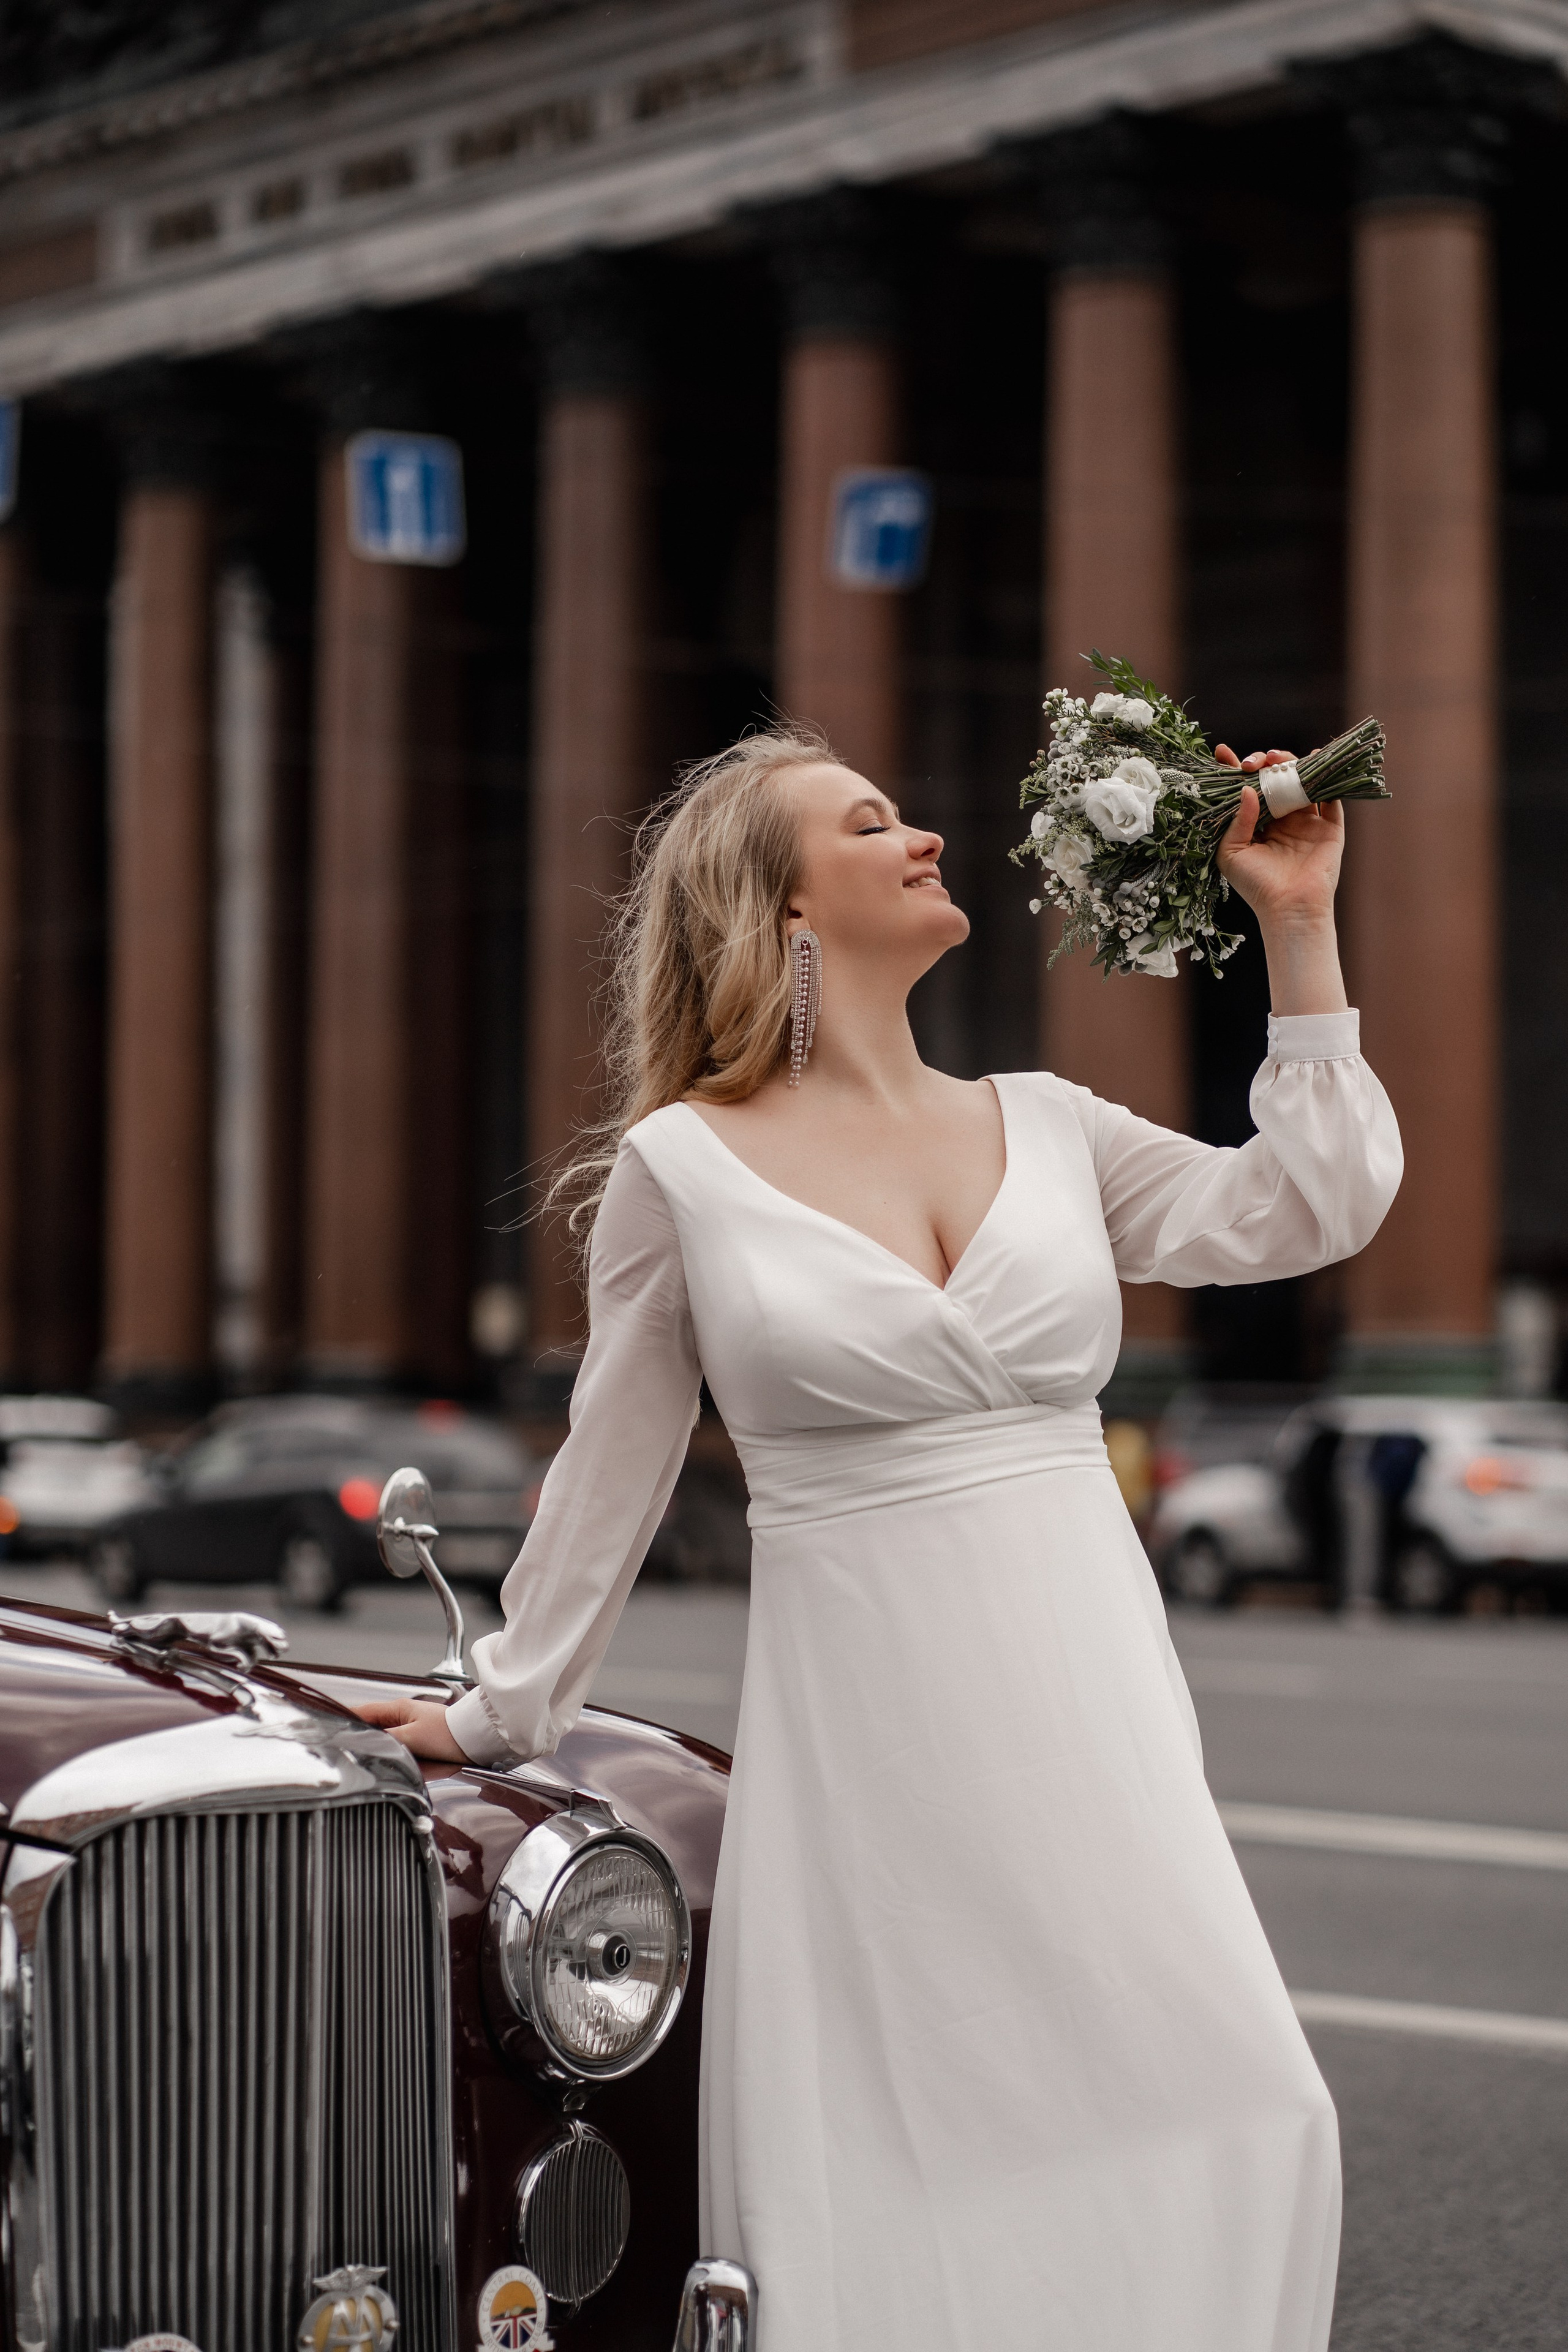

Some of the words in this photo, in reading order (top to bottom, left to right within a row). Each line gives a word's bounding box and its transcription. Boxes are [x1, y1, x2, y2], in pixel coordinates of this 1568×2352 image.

[620, 1948, 627, 1966] J
[481, 2271, 514, 2312] CENTRAL
[519, 2271, 543, 2301] COAST
